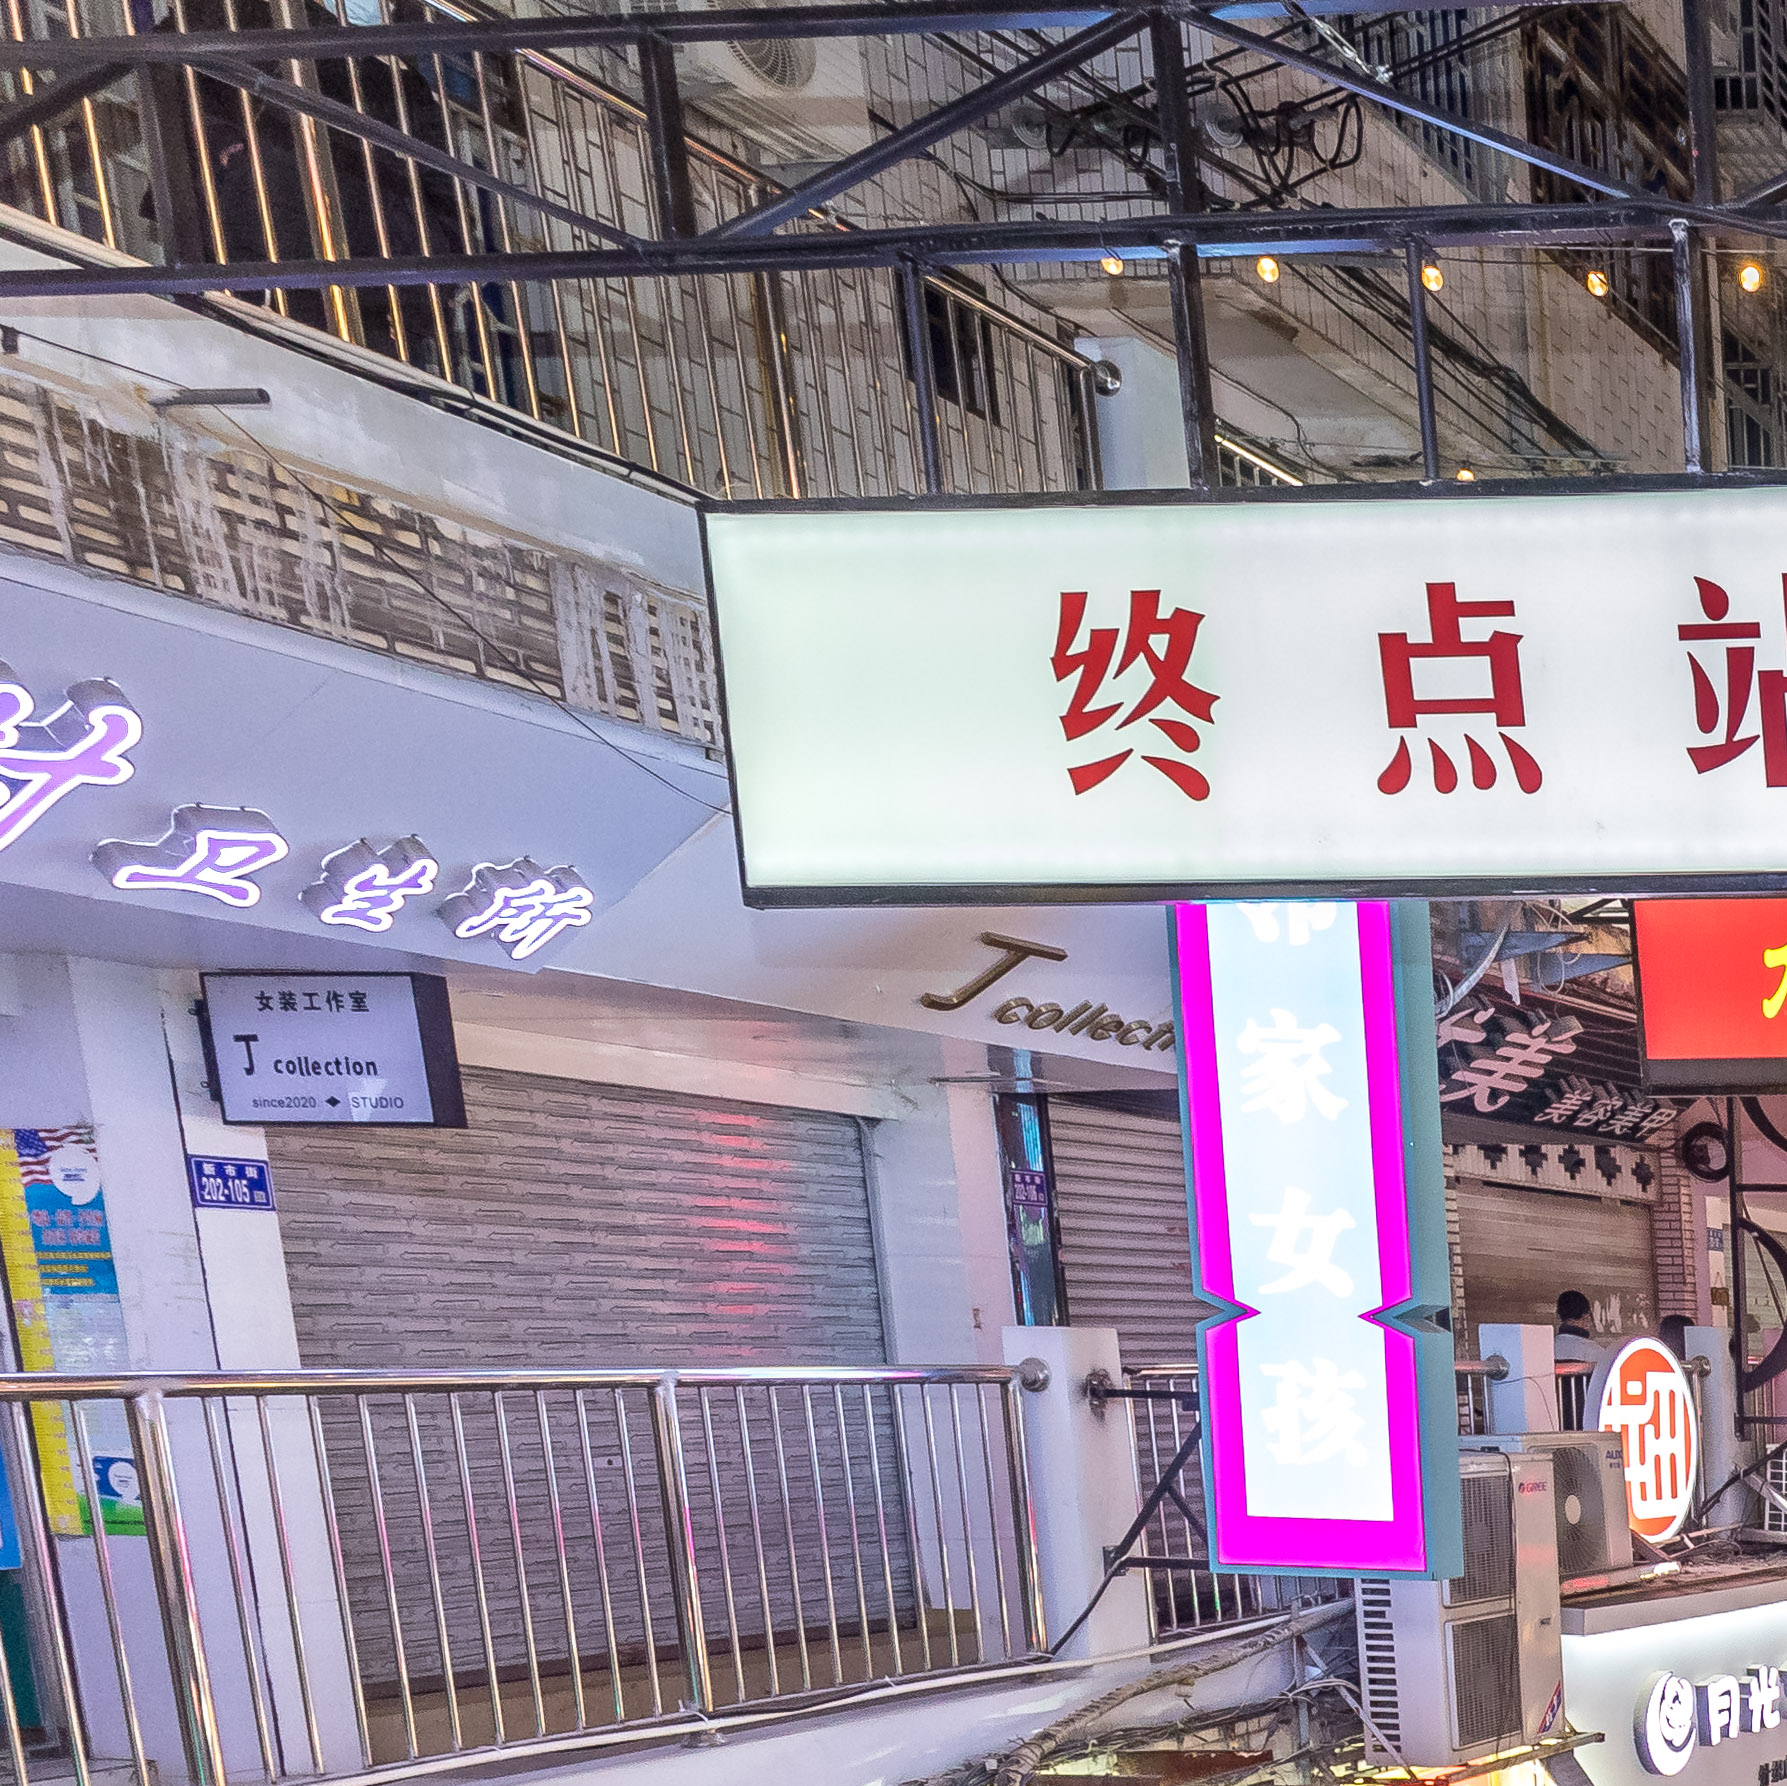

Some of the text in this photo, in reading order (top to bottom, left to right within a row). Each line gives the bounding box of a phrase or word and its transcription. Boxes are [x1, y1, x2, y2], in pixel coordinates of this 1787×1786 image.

[255, 990, 370, 1013] 女装工作室
[233, 1034, 378, 1078] J collection
[252, 1096, 405, 1109] since2020 STUDIO
[201, 1177, 250, 1203] 202-105
